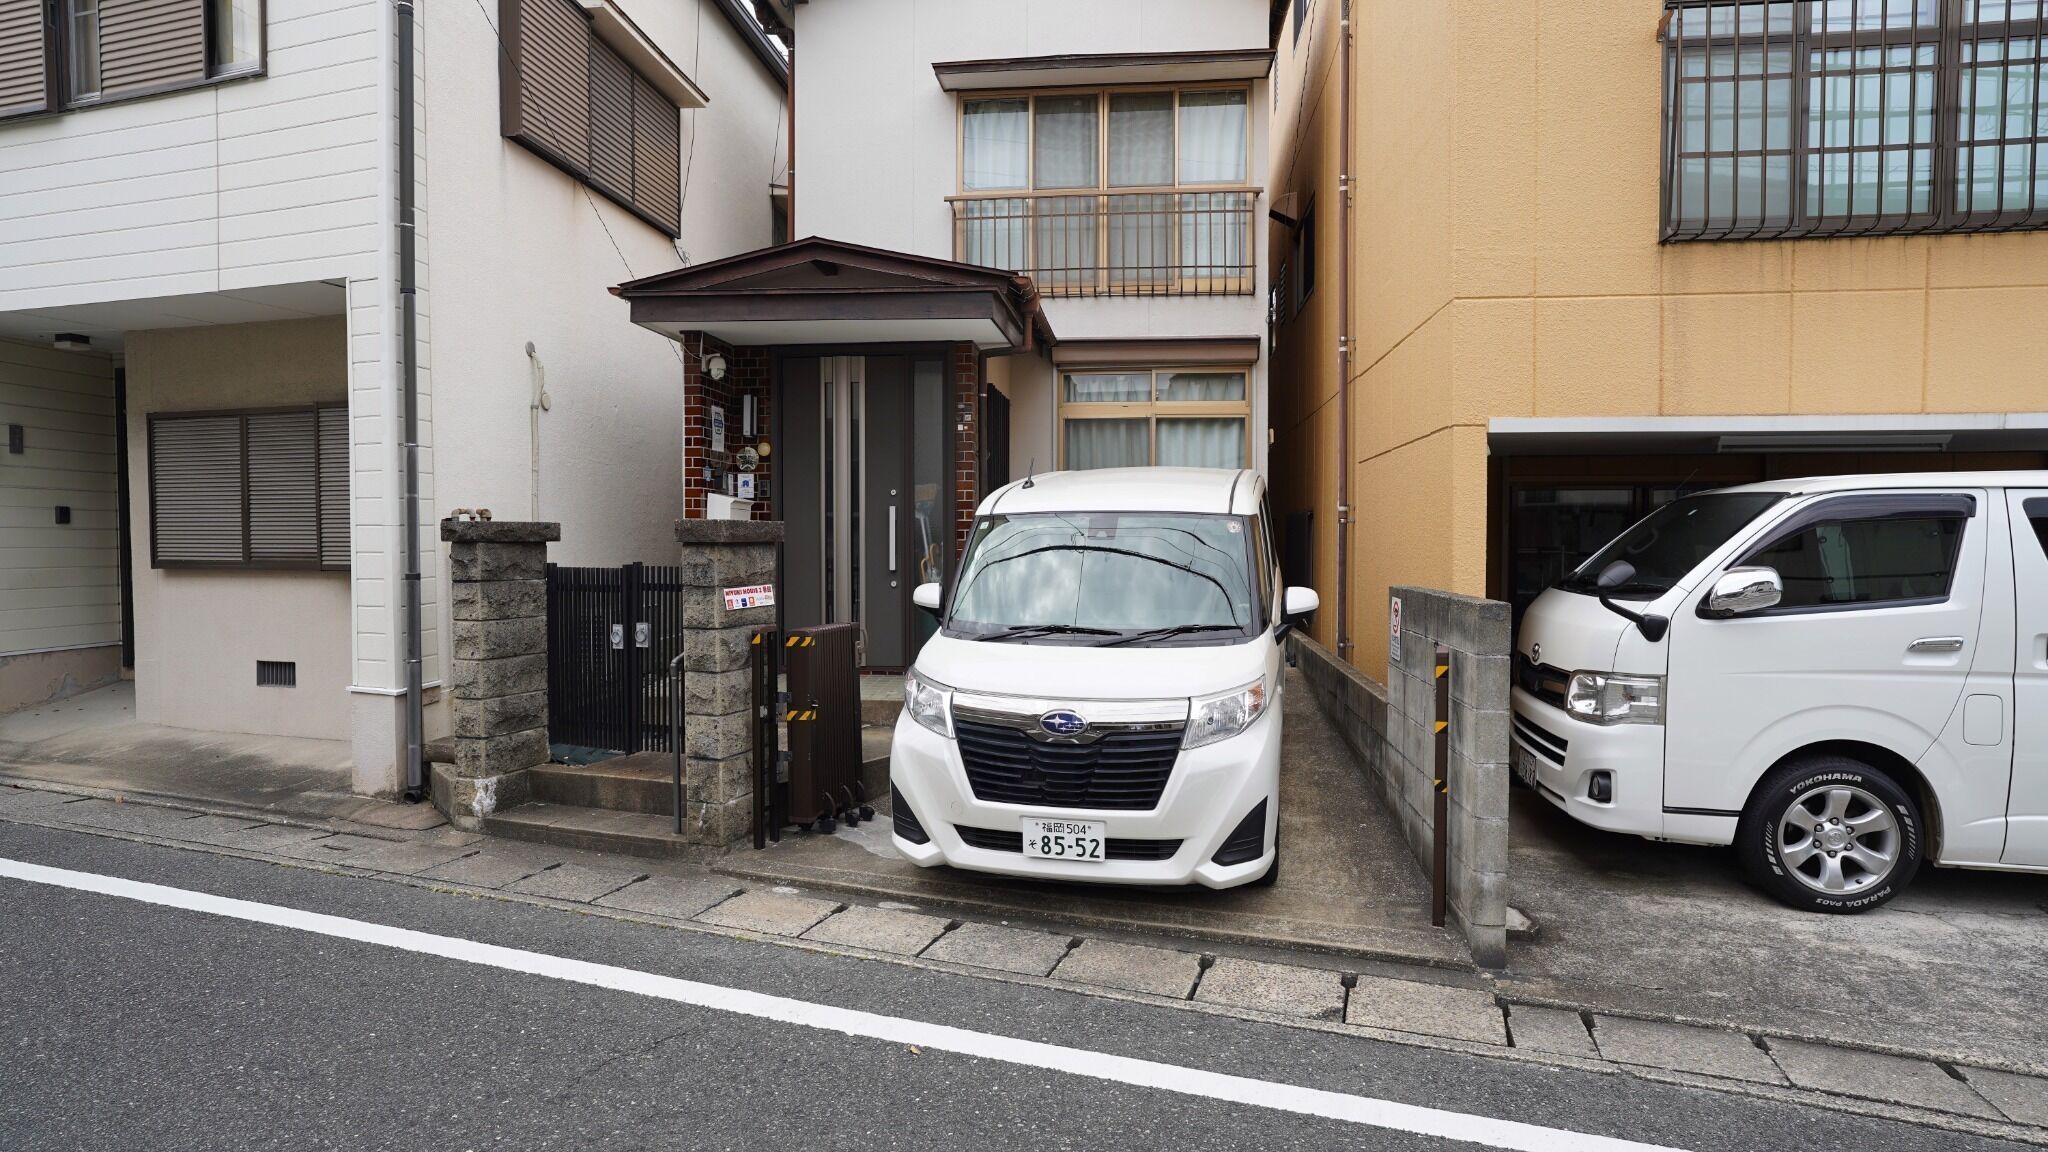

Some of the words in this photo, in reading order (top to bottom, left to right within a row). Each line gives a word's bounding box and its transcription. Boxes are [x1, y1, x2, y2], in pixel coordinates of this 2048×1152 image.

[1789, 773, 1862, 794] YOKOHAMA
[1042, 822, 1065, 833] 福岡
[1066, 823, 1086, 834] 504
[1028, 839, 1037, 849] そ
[1041, 835, 1100, 858] 85-52
[1845, 886, 1891, 907] PARADA
